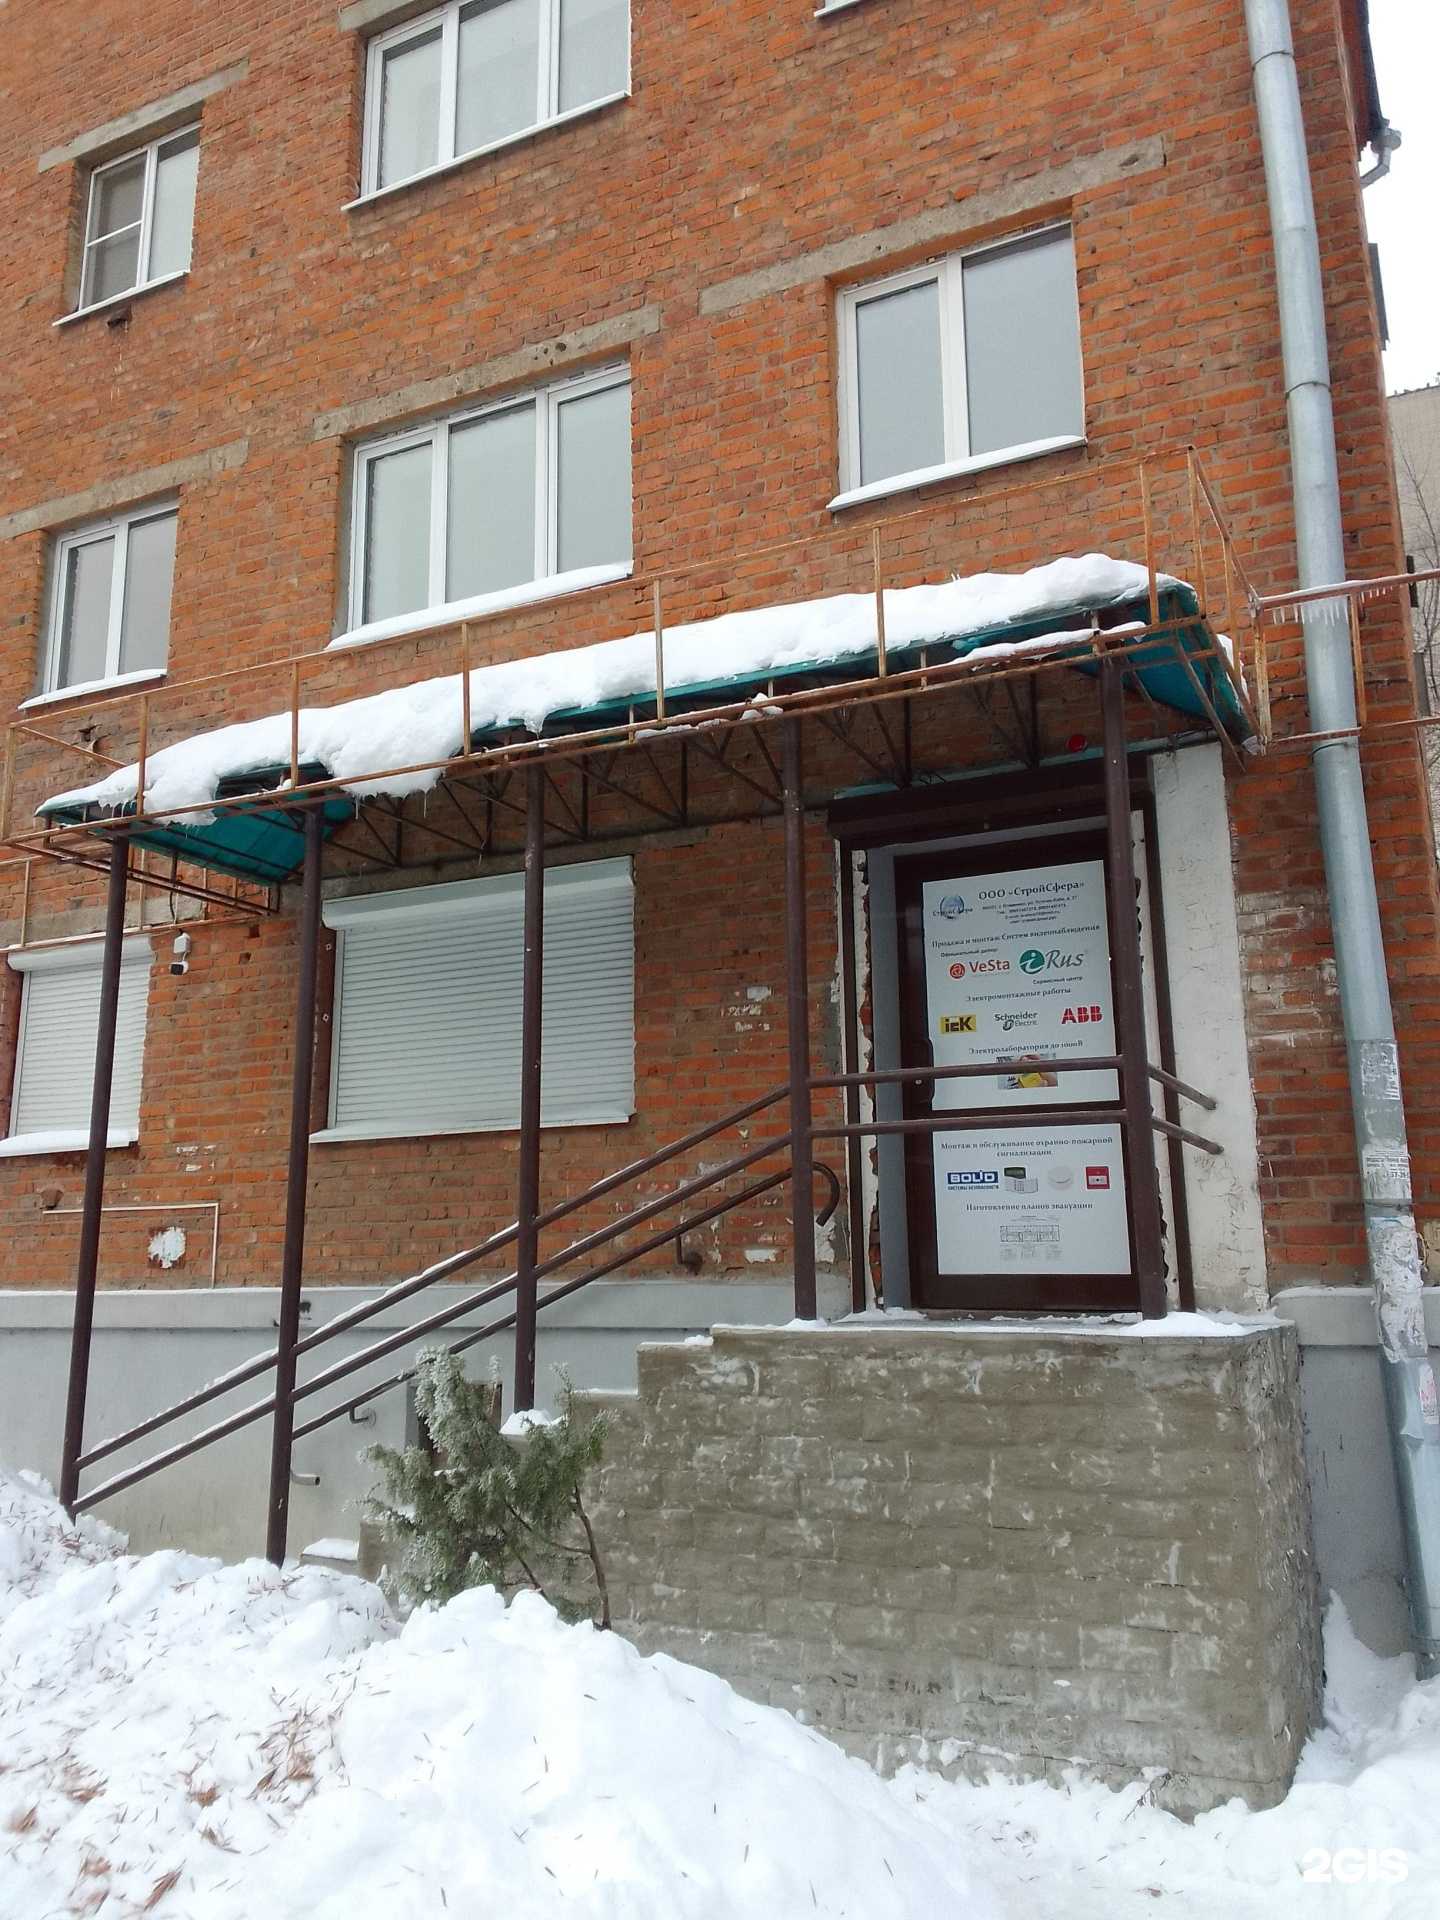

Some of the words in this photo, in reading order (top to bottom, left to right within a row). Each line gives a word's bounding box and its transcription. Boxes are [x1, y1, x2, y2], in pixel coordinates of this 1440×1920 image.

[978, 888, 1006, 900] ООО
[969, 959, 1010, 973] VeSta
[994, 1011, 1038, 1021] Schneider
[1061, 1006, 1103, 1024] ABB
[941, 1142, 971, 1150] Монтаж
